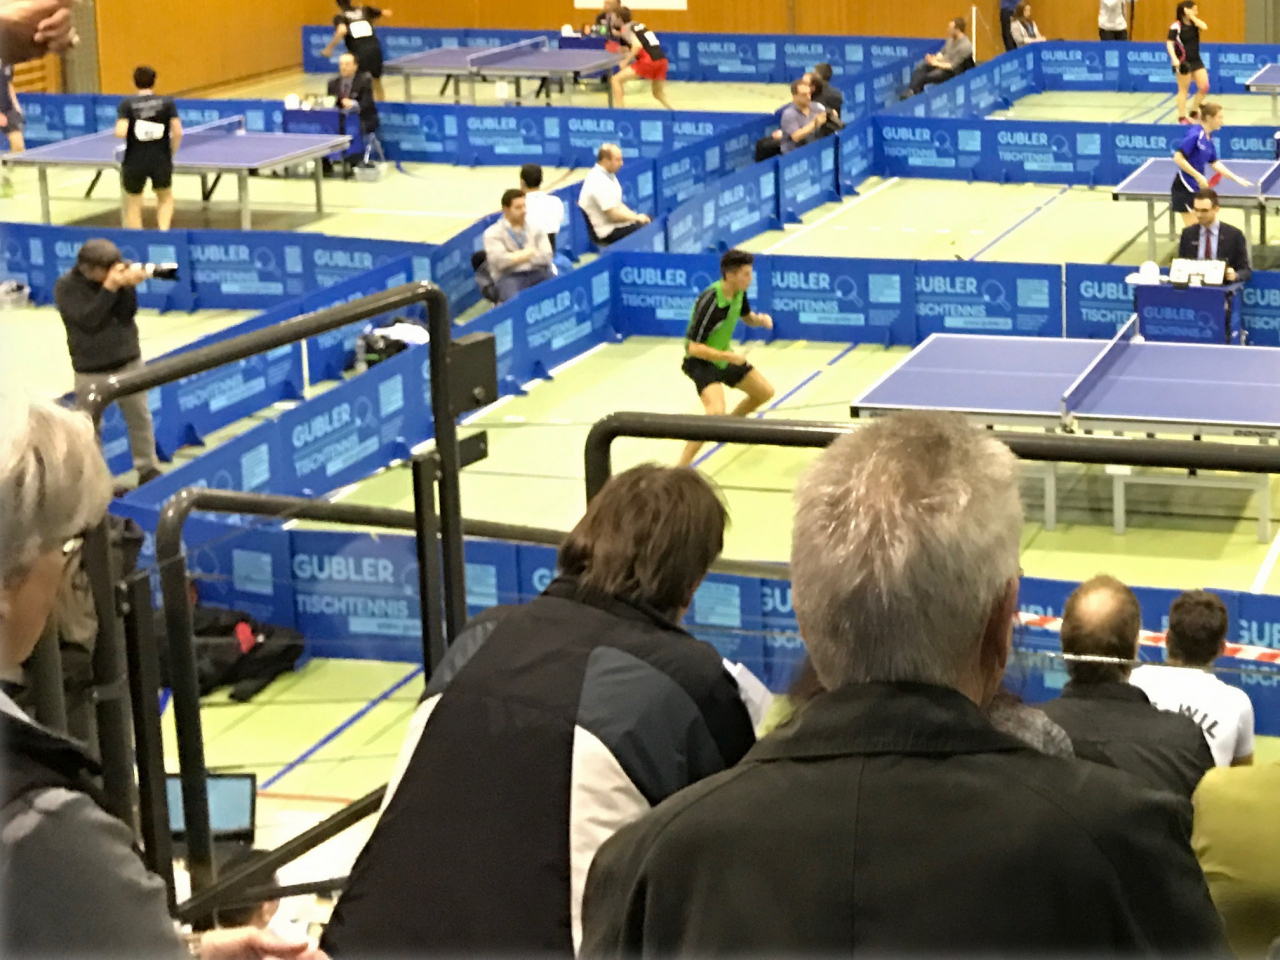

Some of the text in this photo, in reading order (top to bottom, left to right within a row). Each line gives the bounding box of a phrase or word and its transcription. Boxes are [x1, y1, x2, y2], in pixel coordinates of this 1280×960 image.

[883, 126, 931, 141] GUBLER
[998, 131, 1048, 146] GUBLER
[1115, 134, 1167, 149] GUBLER
[620, 266, 687, 286] GUBLER
[293, 553, 394, 583] GUBLER
[296, 593, 408, 617] TISCHTENNIS
